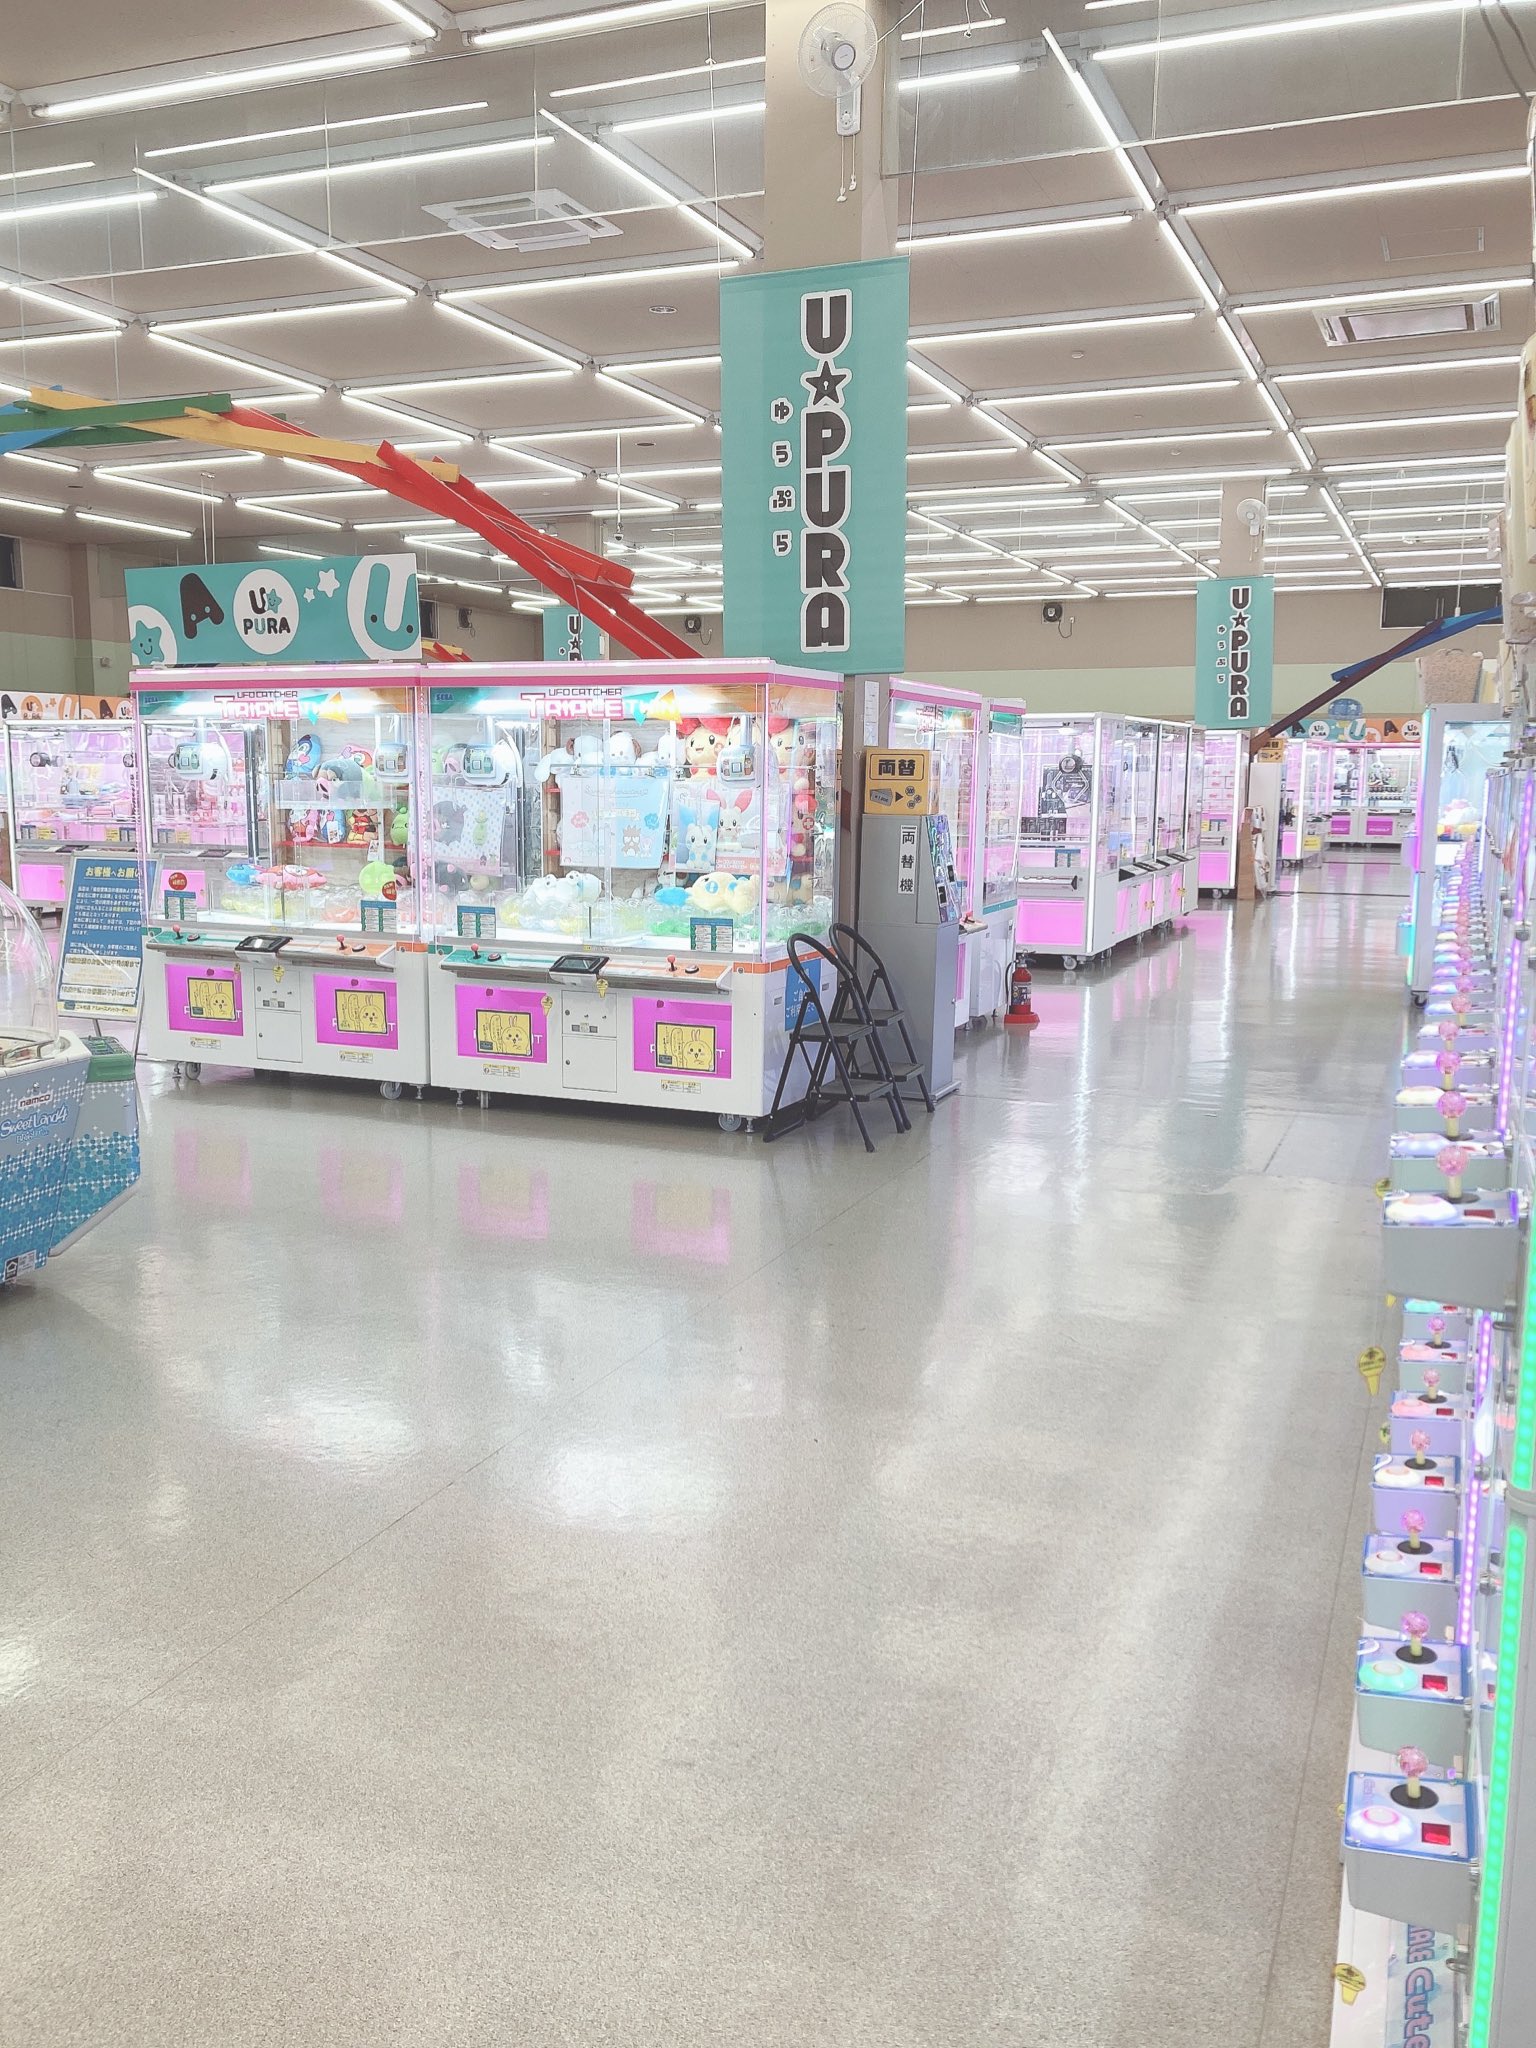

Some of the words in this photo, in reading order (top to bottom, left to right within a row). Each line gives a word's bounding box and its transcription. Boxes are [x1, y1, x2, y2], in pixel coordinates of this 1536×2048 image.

[242, 616, 291, 637] PURA
[878, 759, 916, 777] 両替
[899, 825, 917, 893] 両替機
[20, 1094, 51, 1107] namco
